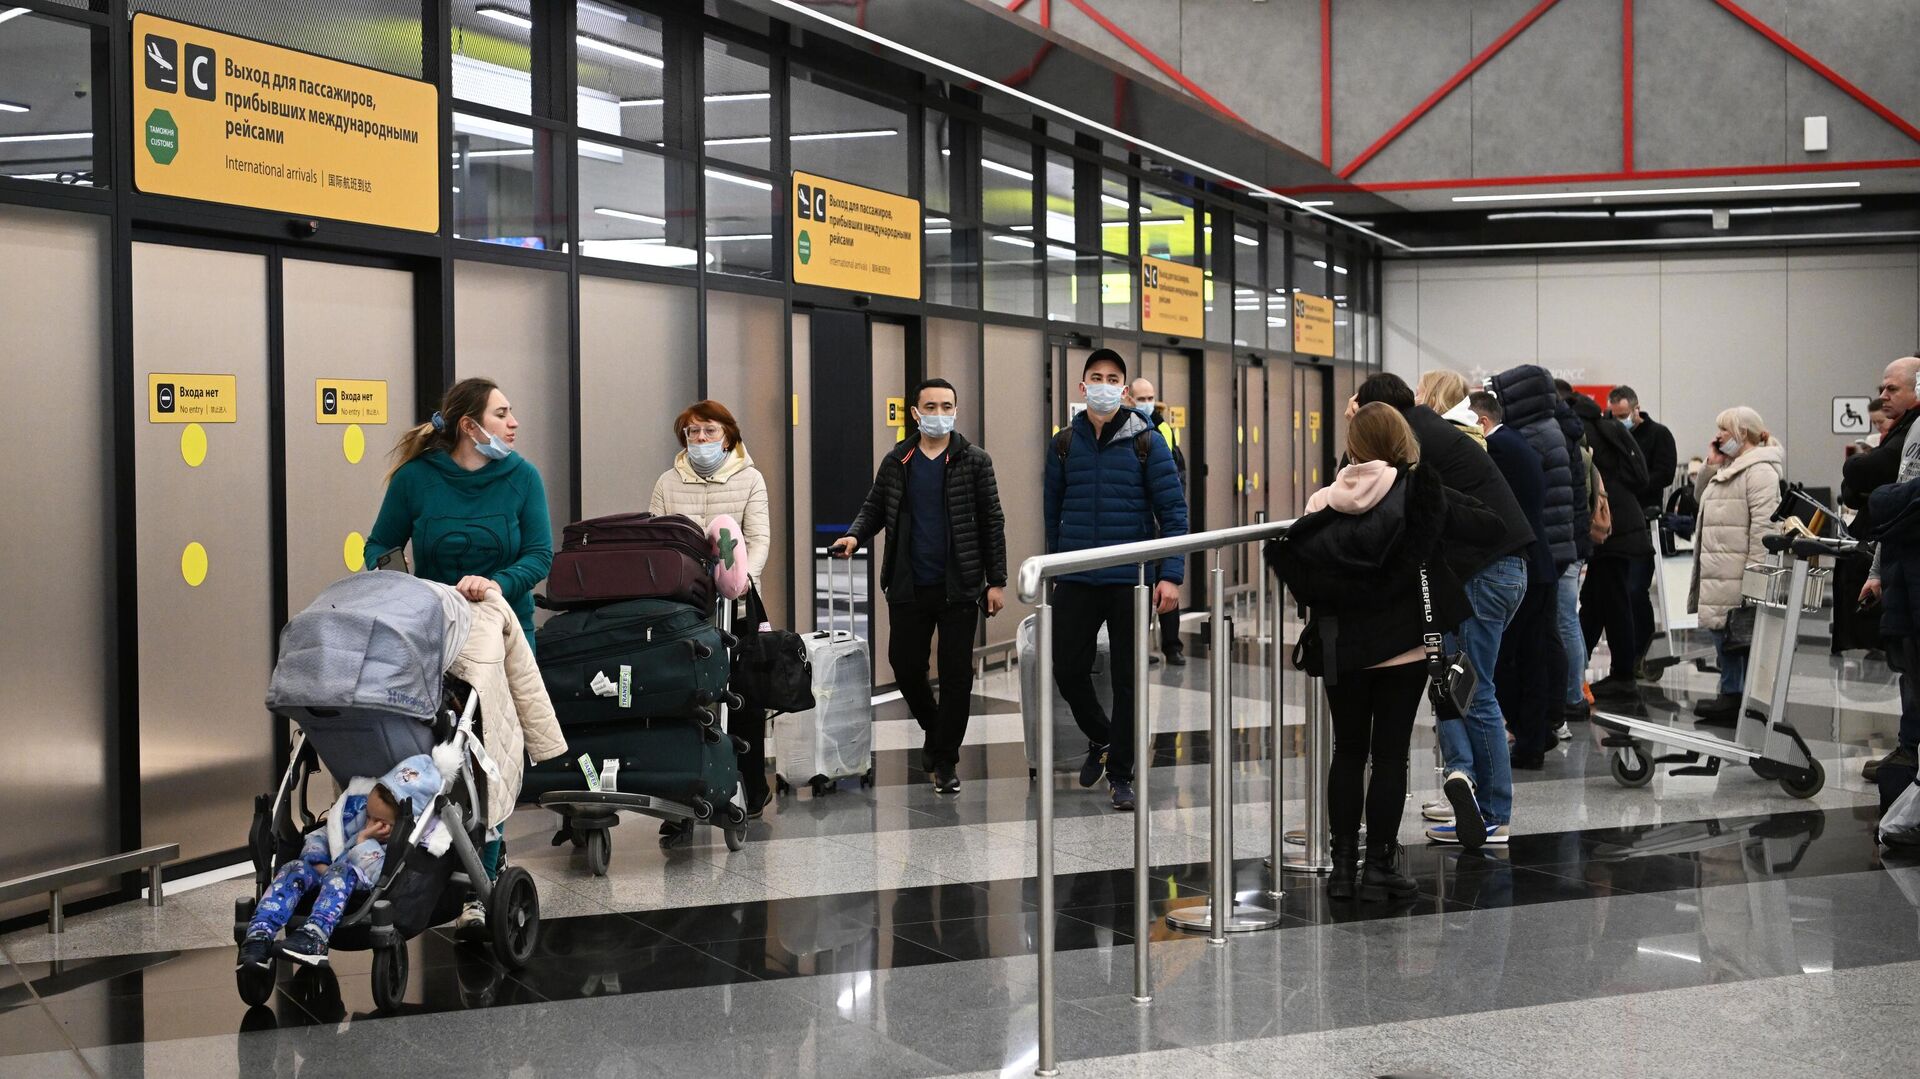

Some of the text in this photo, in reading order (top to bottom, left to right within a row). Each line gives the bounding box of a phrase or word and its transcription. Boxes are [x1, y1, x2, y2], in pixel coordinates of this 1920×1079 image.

[192, 55, 209, 91] C
[224, 57, 377, 110] Выход для пассажиров,
[225, 91, 419, 144] прибывших международными
[150, 125, 175, 137] ТАМОЖНЯ
[150, 138, 174, 149] CUSTOMS
[225, 119, 284, 145] рейсами
[225, 155, 372, 193] International arrivals 国际航班到达
[816, 193, 824, 217] C
[179, 386, 219, 399] Входа нет
[341, 391, 373, 403] Входа нет
[180, 405, 188, 414] No
[188, 406, 204, 415] entry
[1420, 569, 1432, 623] LAGERFELD
[583, 759, 598, 787] TRANSFER
